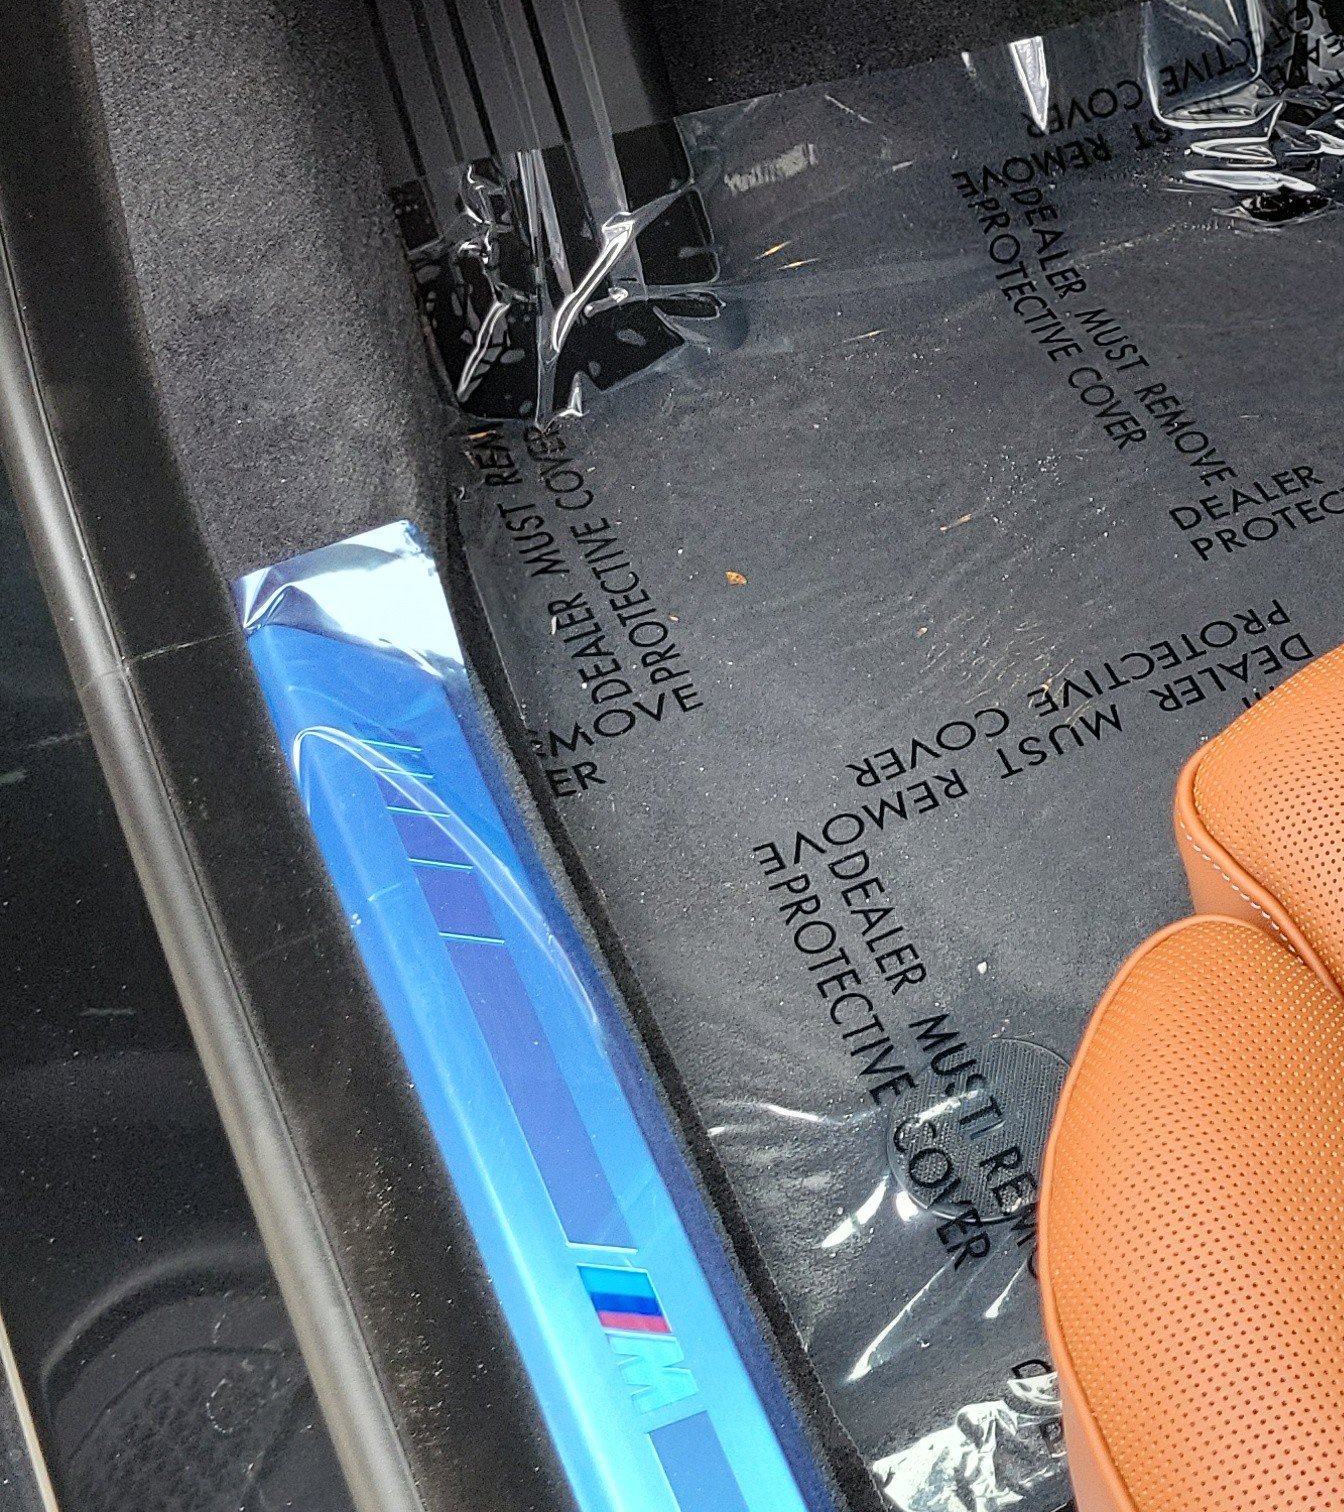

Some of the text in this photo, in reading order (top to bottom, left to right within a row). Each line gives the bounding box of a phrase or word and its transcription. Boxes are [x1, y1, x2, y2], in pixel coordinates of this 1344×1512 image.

[951, 136, 1112, 200] REMOVE
[967, 197, 1147, 450] PROTECTIVE COVER
[1011, 188, 1238, 486] DEALER MUST REMOVE
[496, 502, 570, 578] MUST
[1168, 465, 1324, 531] DEALER
[547, 591, 633, 705] DEALER
[570, 517, 691, 685] PROTECTIVE
[751, 632, 1315, 877] DEALER MUST REMOVE
[845, 598, 1292, 788] PROTECTIVE COVER
[827, 847, 928, 996] DEALER
[769, 873, 991, 1270] PROTECTIVE COVER
